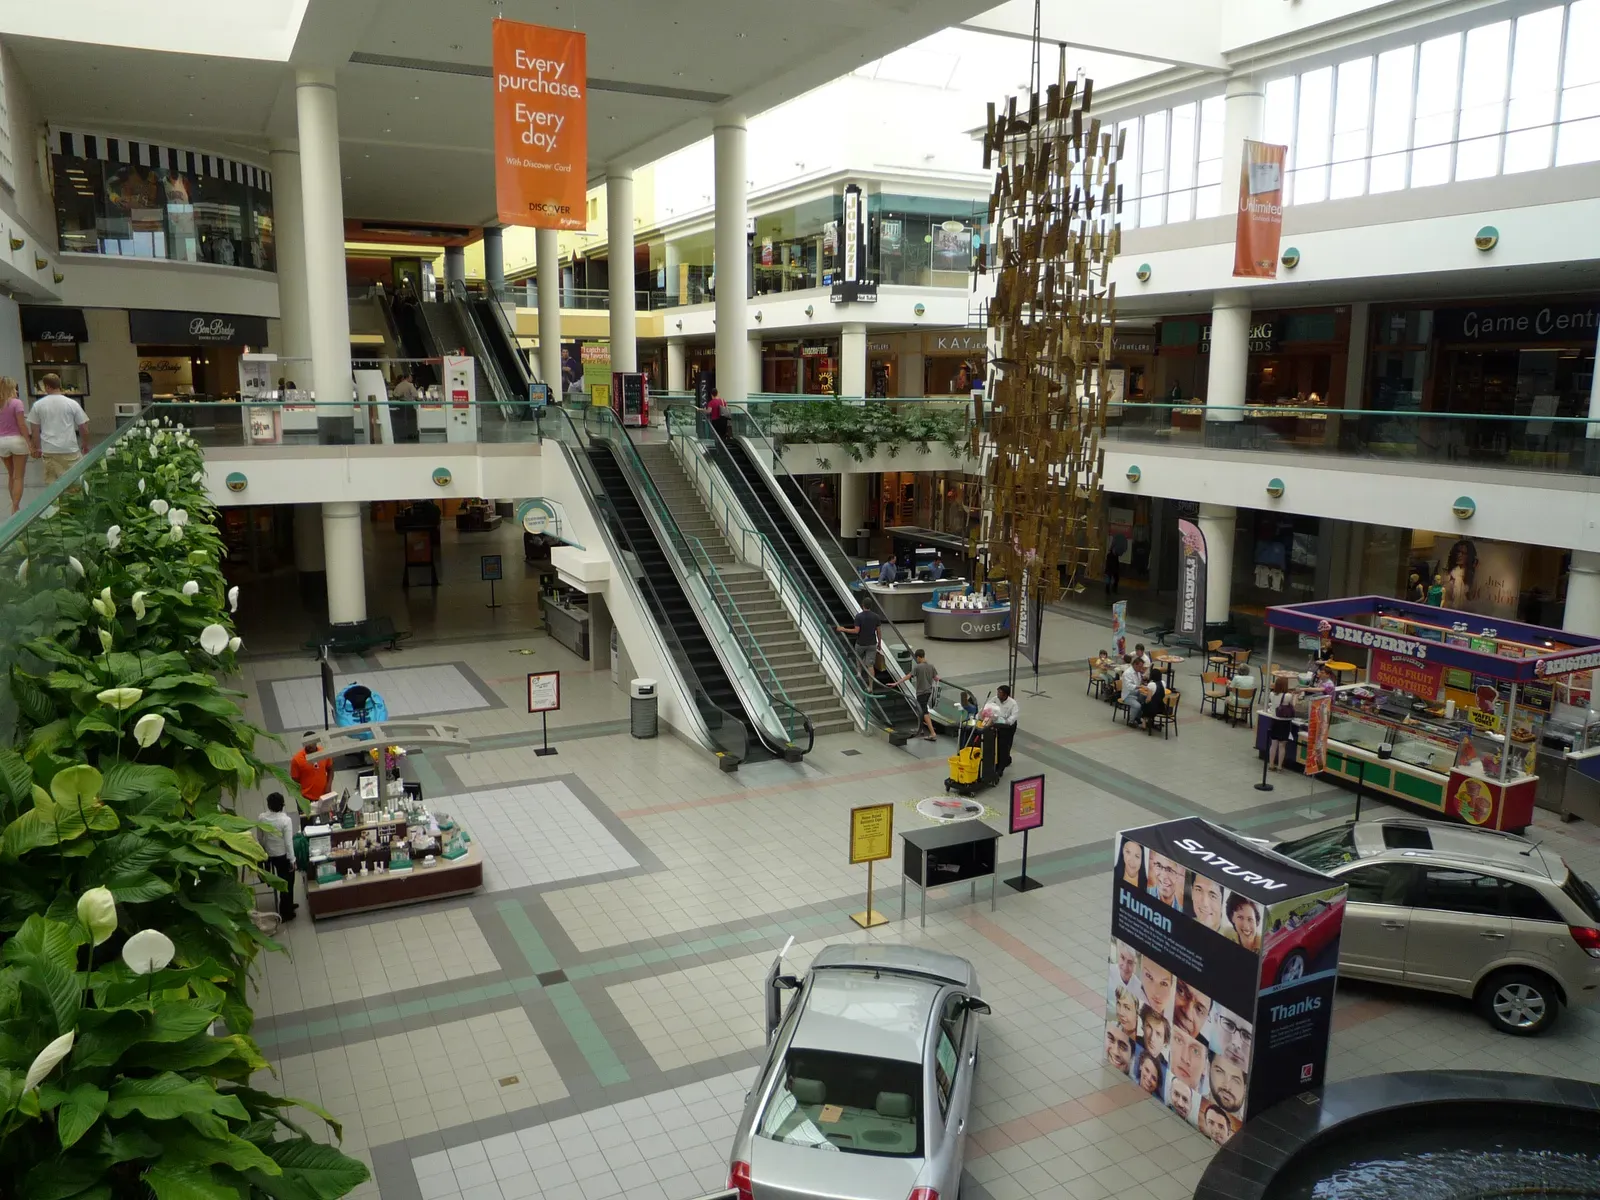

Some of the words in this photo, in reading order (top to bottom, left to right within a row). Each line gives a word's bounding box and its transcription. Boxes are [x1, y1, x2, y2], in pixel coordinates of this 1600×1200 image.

[515, 49, 565, 80] Every
[498, 72, 581, 99] purchase.
[515, 103, 565, 133] Every
[521, 123, 557, 153] day.
[506, 156, 521, 166] With
[523, 159, 553, 170] Discover
[554, 163, 571, 172] Card
[529, 202, 570, 215] DISCOVER
[846, 196, 857, 279] Jacuzzi
[41, 331, 56, 341] Ben
[55, 331, 75, 342] Bridge
[188, 317, 210, 335] Ben
[209, 318, 236, 341] Bridge
[1202, 322, 1273, 341] HERG
[1463, 311, 1529, 339] Game
[938, 337, 971, 349] KAY
[1201, 340, 1272, 353] DNDS
[155, 360, 182, 374] Bridge
[960, 621, 1001, 635] Qwest
[1334, 624, 1428, 659] BEN&JERRY'S
[1376, 671, 1434, 697] SMOOTHIES
[1379, 661, 1404, 677] REAL
[1405, 668, 1434, 685] FRUIT
[1472, 710, 1495, 722] WAFFLE
[1173, 838, 1288, 890] SATURN
[1118, 887, 1173, 934] Human
[1269, 996, 1323, 1023] Thanks
